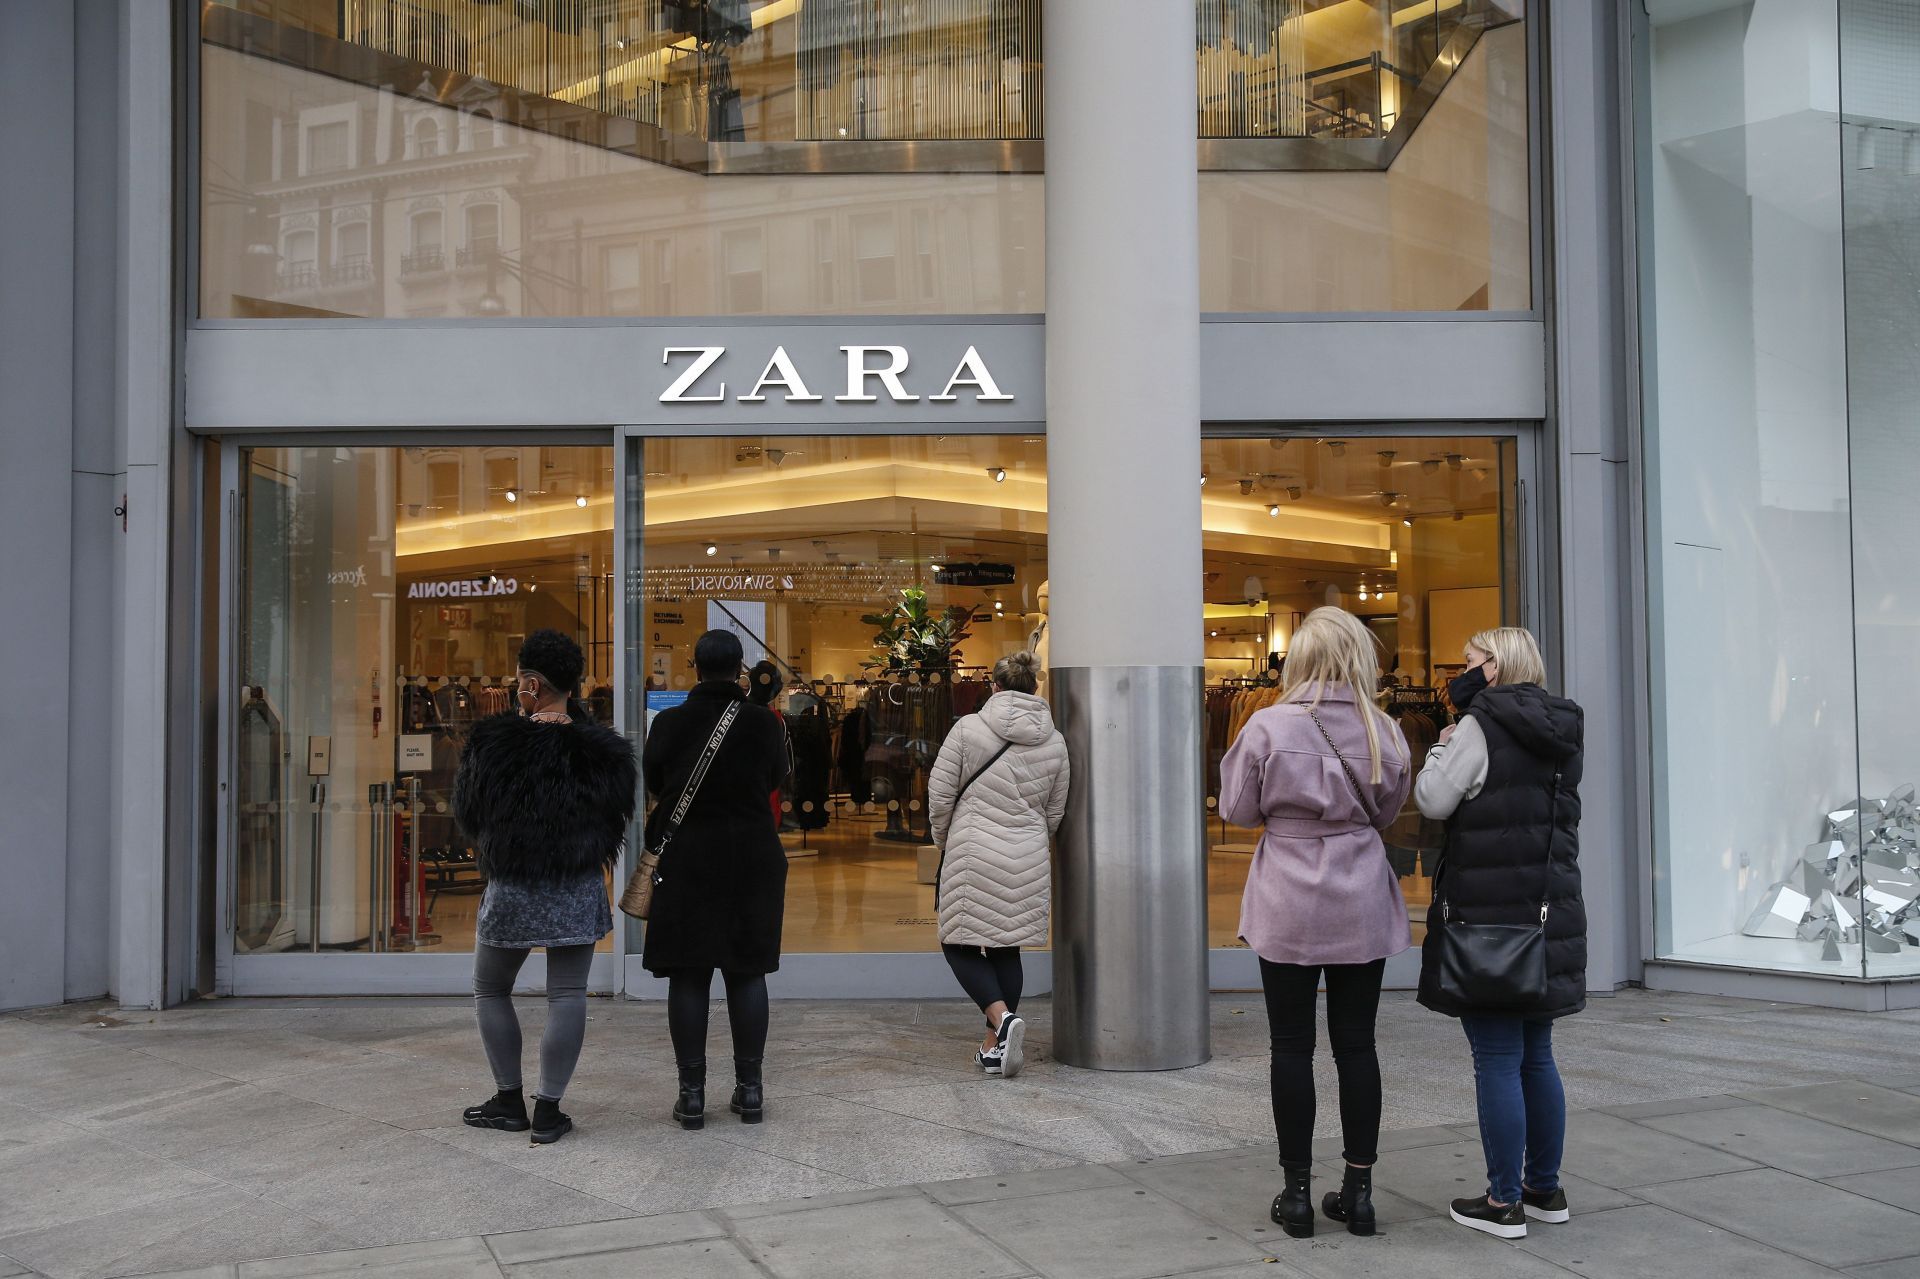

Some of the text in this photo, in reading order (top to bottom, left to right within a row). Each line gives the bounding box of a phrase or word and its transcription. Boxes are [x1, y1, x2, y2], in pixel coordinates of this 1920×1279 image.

[658, 345, 1015, 402] ZARA
[709, 712, 734, 750] HAVE FUN
[676, 793, 691, 816] HAVE
